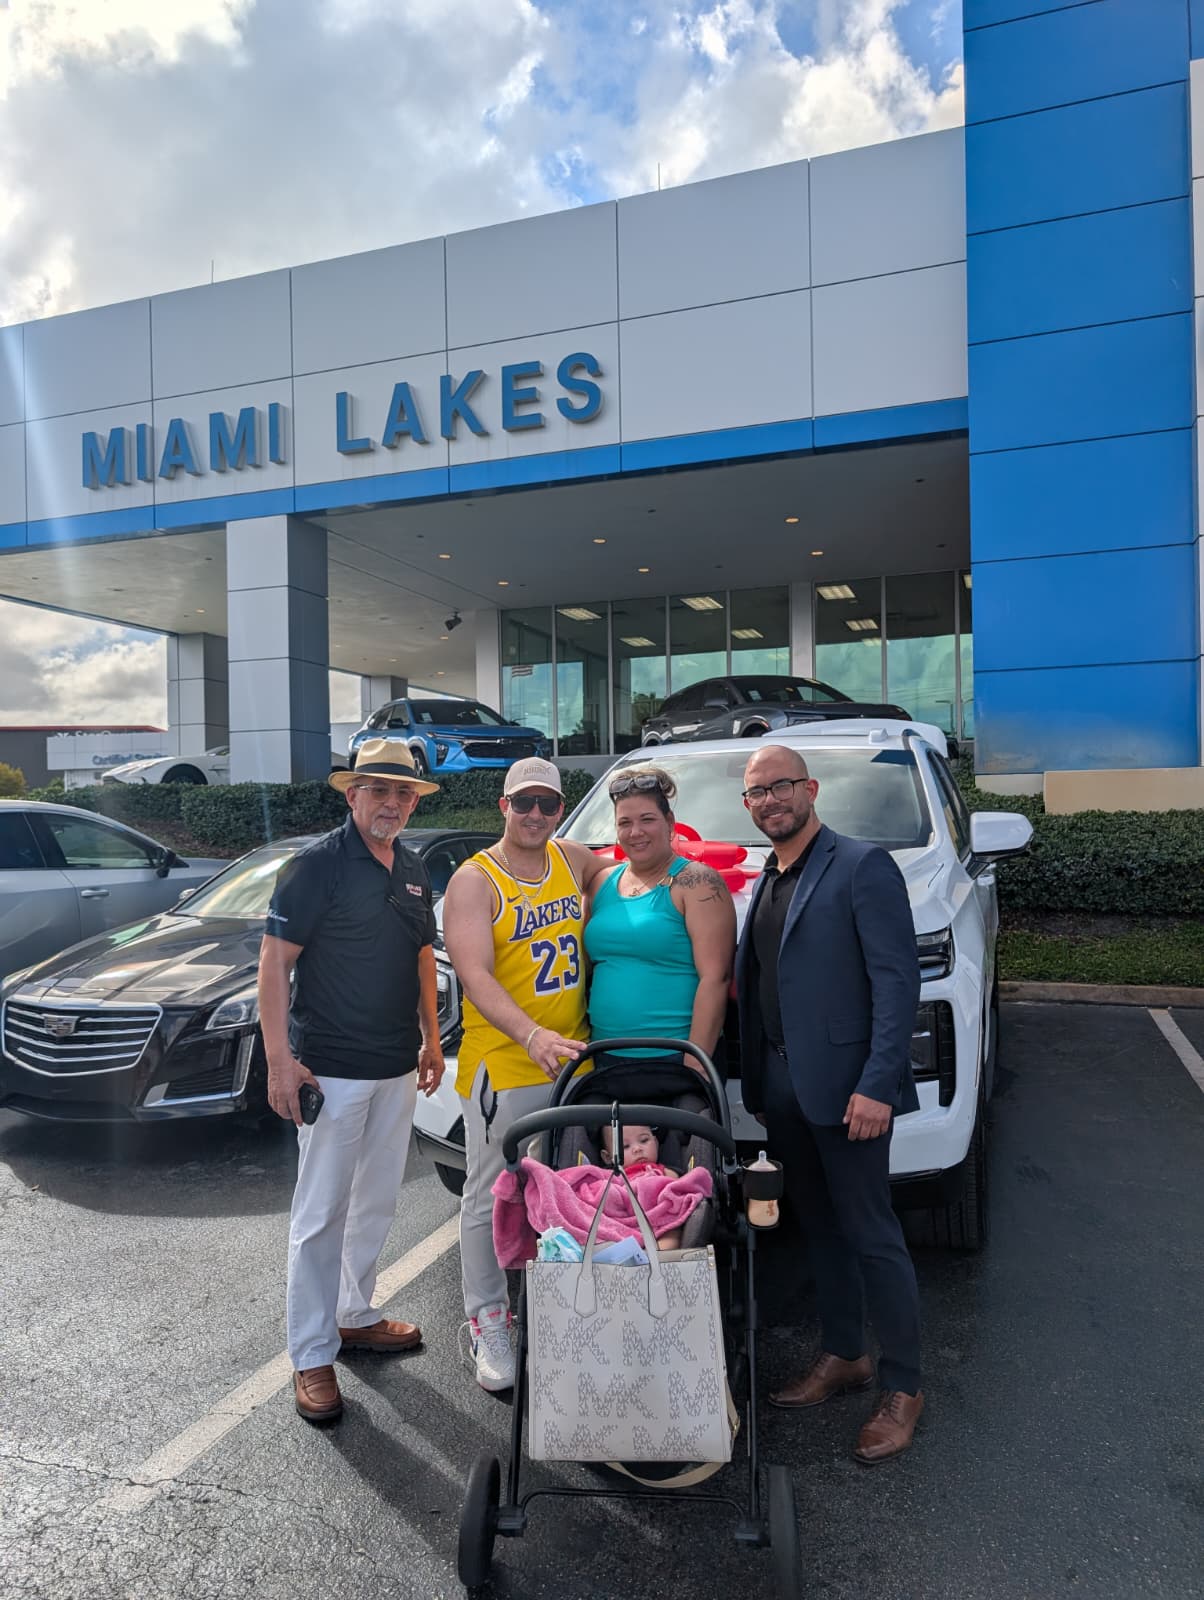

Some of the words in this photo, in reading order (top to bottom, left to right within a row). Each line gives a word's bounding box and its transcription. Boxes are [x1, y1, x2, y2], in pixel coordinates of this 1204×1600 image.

[82, 402, 285, 489] MIAMI
[336, 352, 603, 455] LAKES
[508, 894, 581, 941] LAKERS
[530, 933, 580, 996] 23
